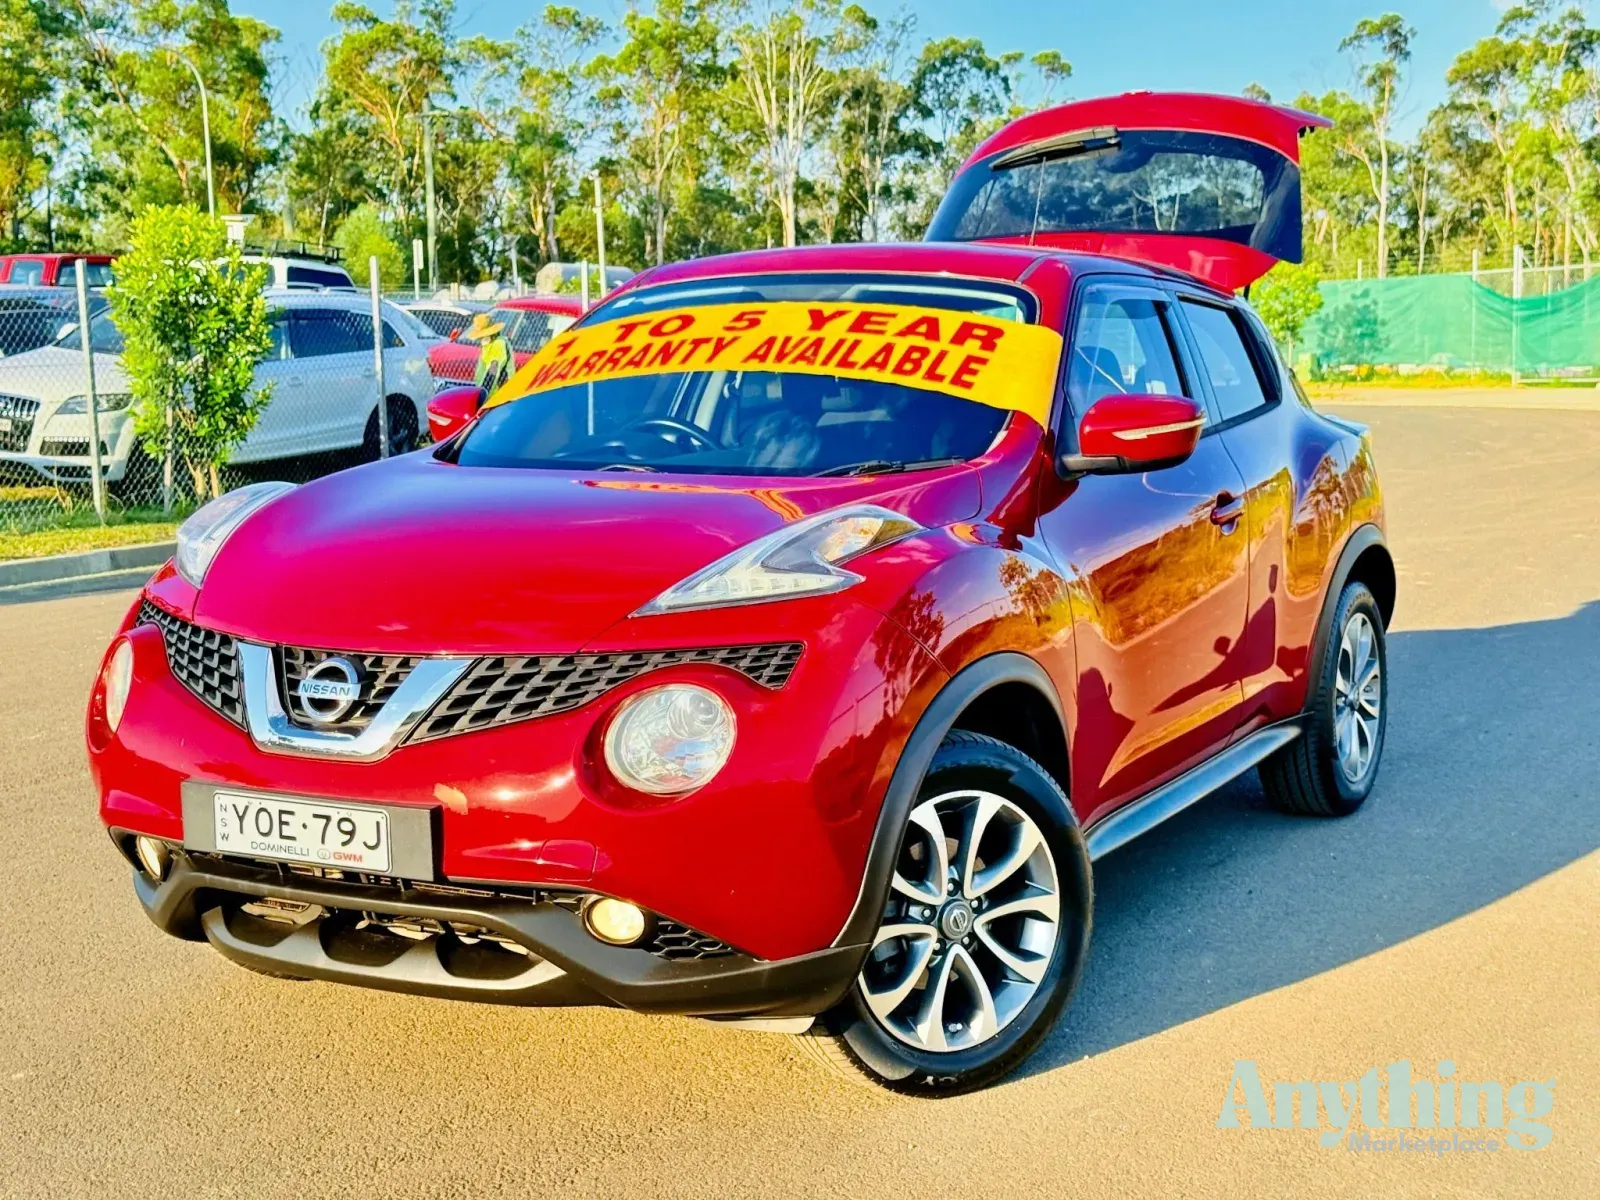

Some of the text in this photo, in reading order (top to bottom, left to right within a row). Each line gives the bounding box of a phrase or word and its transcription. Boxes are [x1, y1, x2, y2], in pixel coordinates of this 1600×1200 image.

[556, 309, 1006, 357] 1 TO 5 YEAR
[525, 335, 990, 391] WARRANTY AVAILABLE
[301, 683, 350, 696] NISSAN
[250, 841, 363, 862] DOMINELLI GWM
